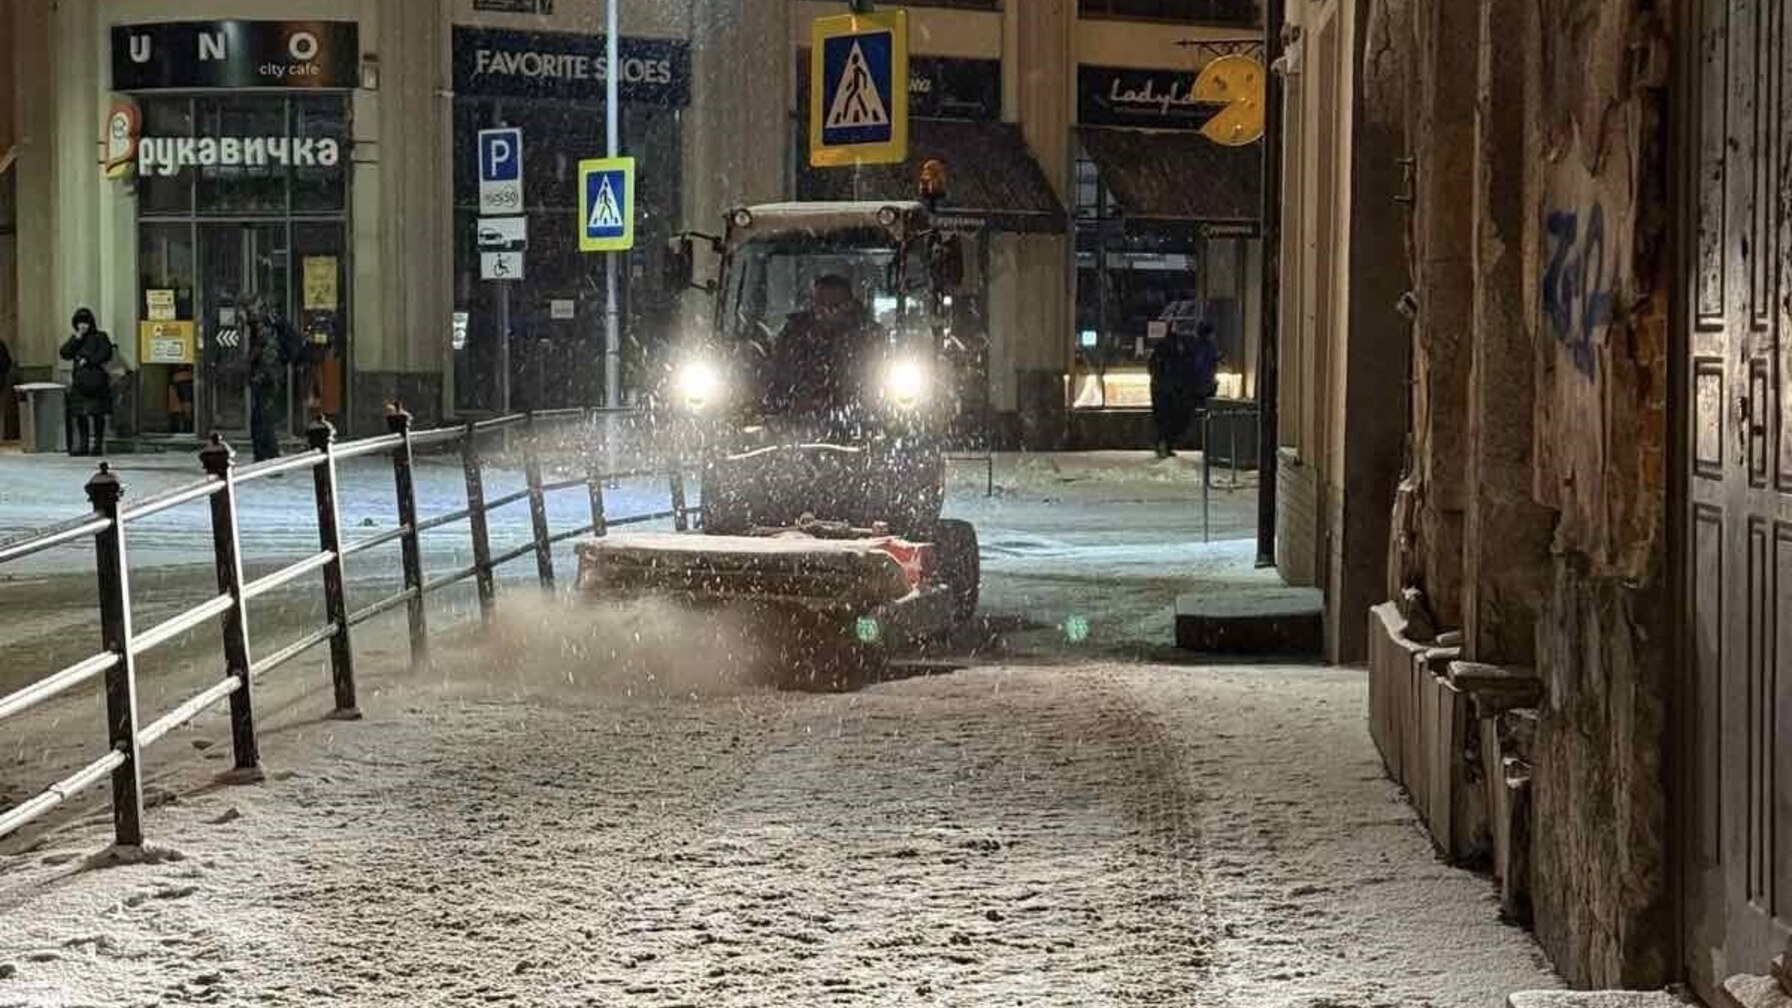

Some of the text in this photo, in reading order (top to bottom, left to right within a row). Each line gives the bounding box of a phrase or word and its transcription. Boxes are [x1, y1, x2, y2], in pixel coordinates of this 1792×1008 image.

[259, 63, 321, 78] city cafe
[475, 50, 589, 80] FAVORITE
[1110, 78, 1195, 115] LadyLa
[138, 137, 339, 176] рукавичка
[490, 139, 510, 177] P
